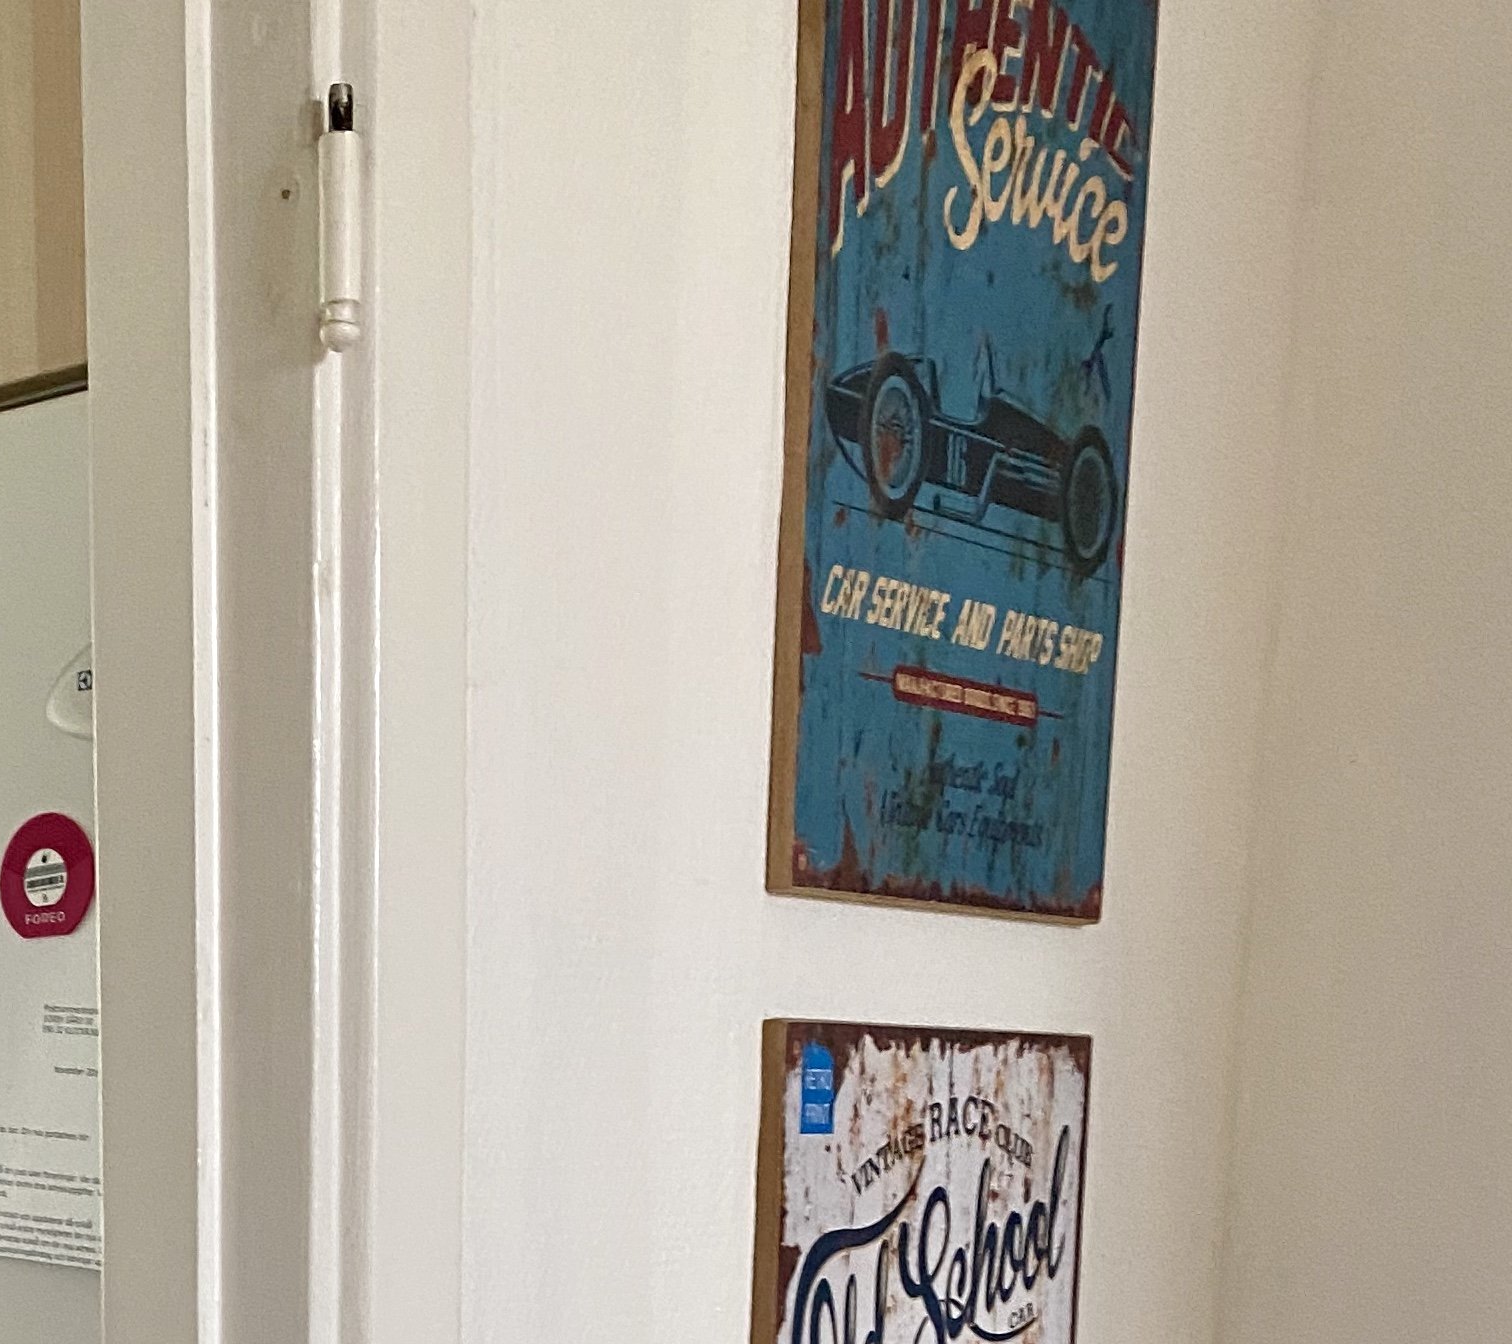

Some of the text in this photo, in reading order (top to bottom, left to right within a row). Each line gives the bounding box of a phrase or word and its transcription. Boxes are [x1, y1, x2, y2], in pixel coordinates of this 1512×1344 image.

[944, 42, 1129, 282] Service
[947, 432, 967, 486] 16
[820, 564, 1104, 675] CAR SERVICE AND PARTS SHOP
[851, 1123, 925, 1196] VINTAGE
[929, 1095, 996, 1143] RACE
